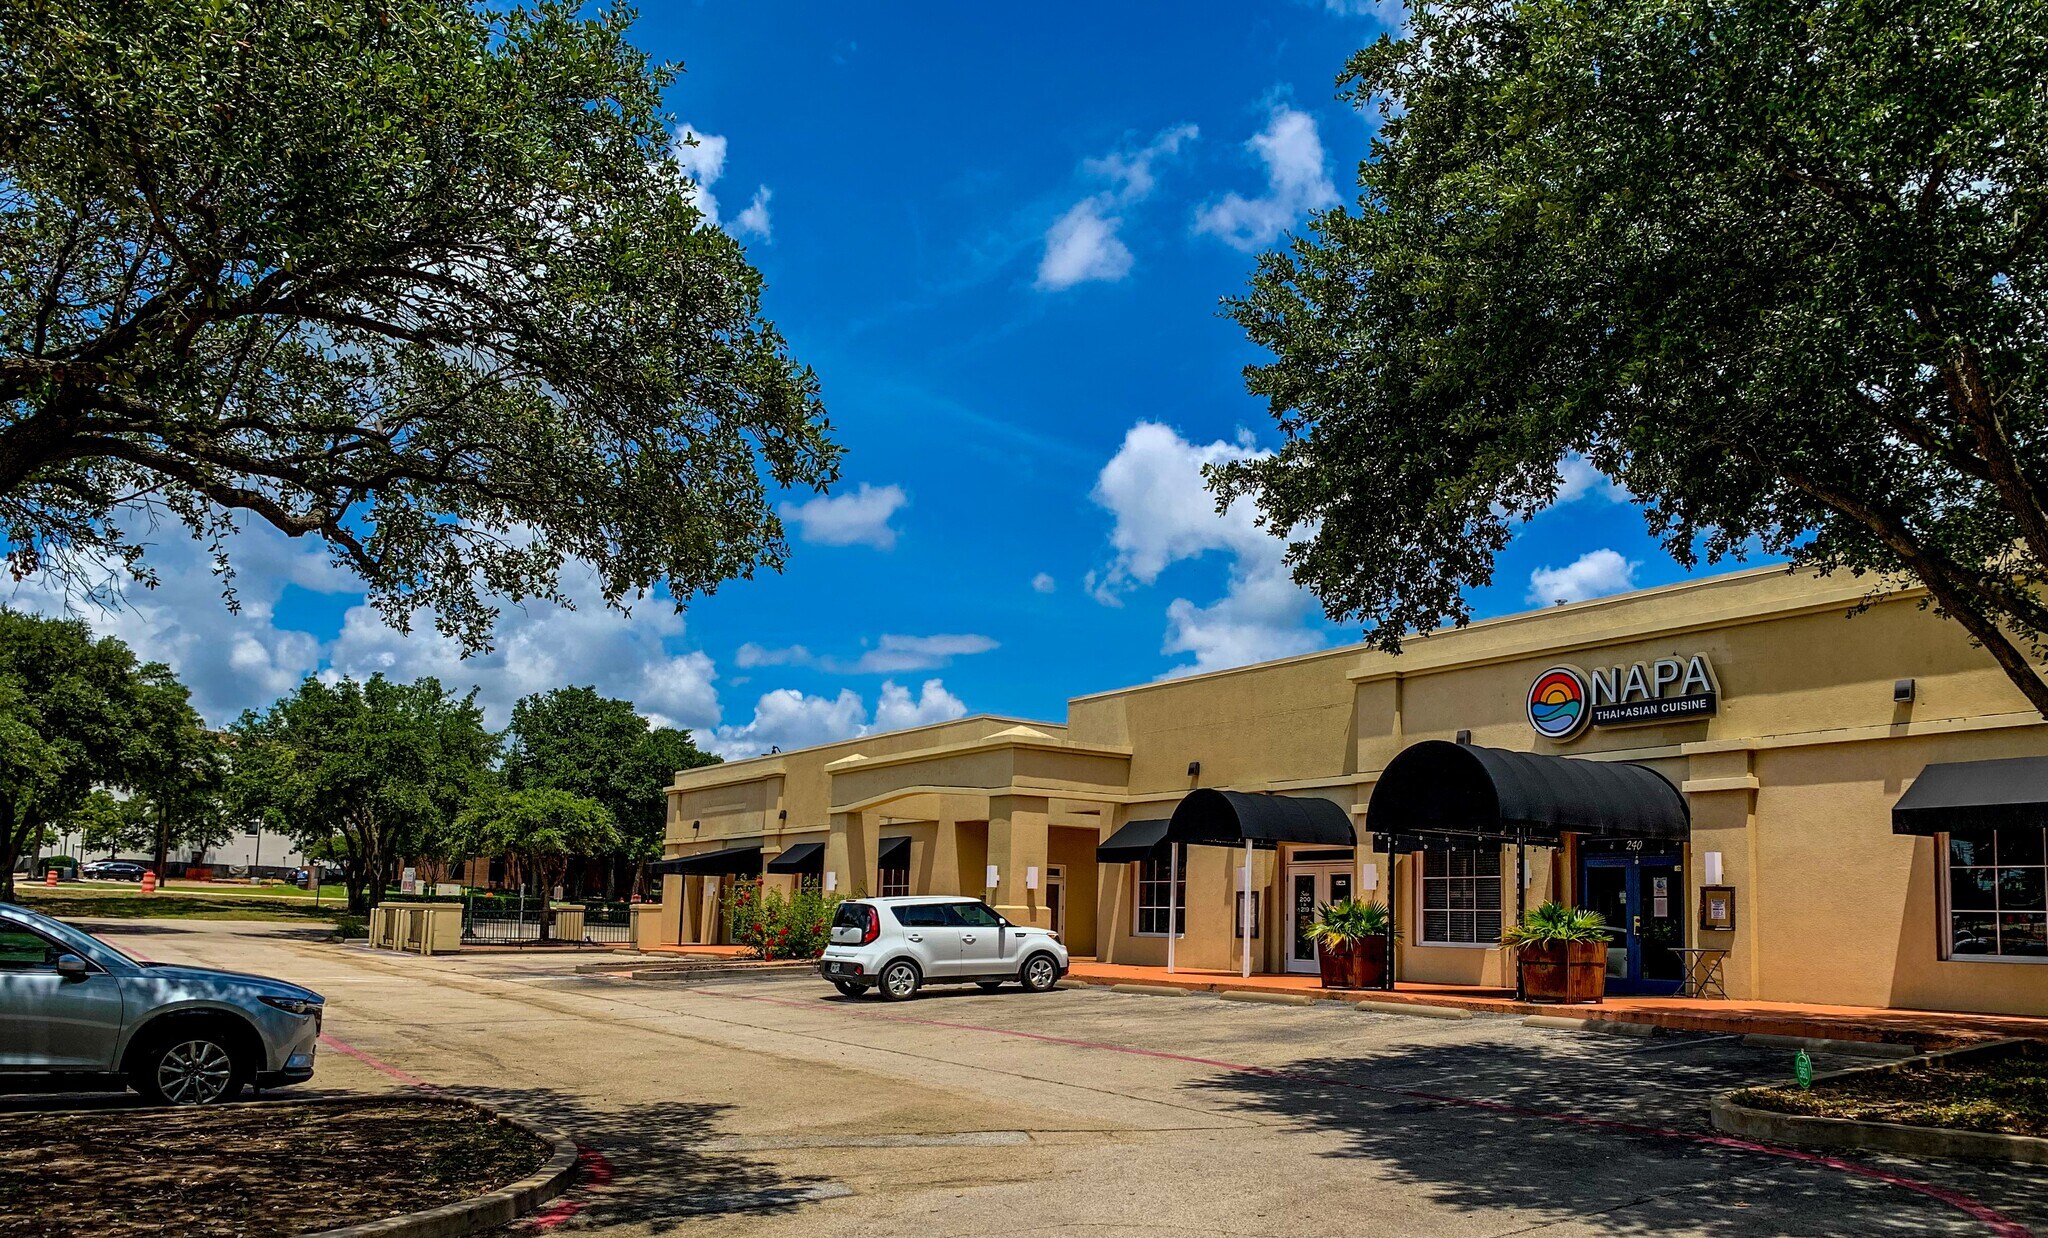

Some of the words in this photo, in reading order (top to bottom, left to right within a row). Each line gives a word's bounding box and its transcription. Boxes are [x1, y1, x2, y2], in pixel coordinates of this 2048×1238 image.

[1591, 655, 1713, 705] NAPA
[1661, 699, 1707, 713] CUISINE
[1626, 840, 1643, 851] 240
